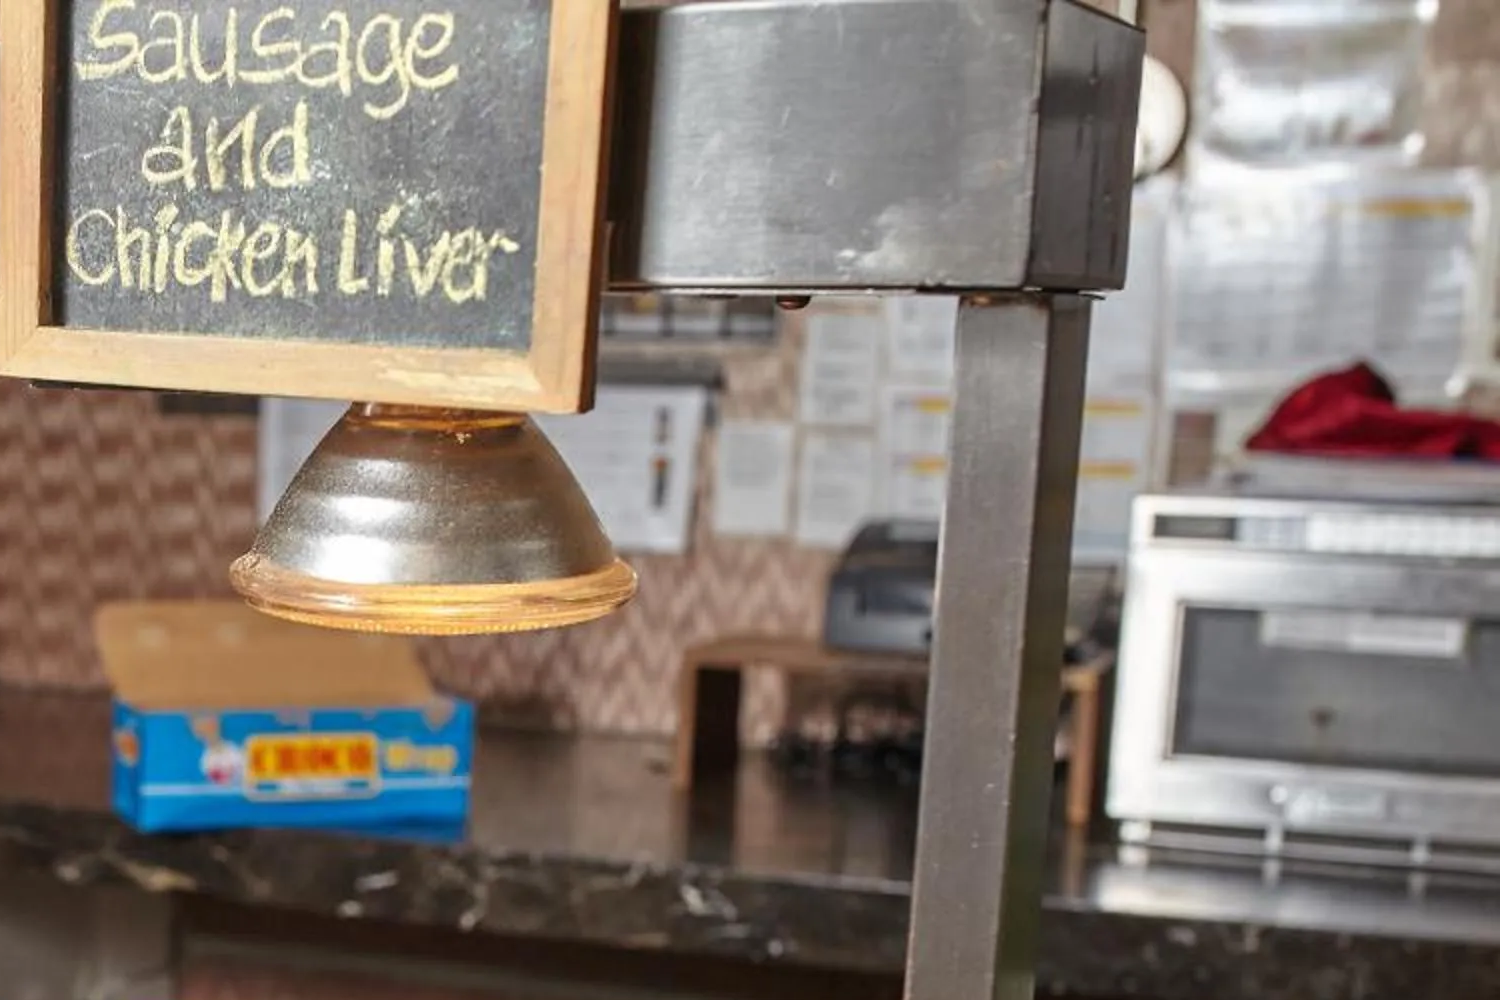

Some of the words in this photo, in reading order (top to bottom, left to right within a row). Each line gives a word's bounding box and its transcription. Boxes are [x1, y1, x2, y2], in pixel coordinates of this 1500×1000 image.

[75, 0, 459, 118] Sausage
[142, 100, 311, 191] and
[65, 203, 318, 302] Chicken
[337, 204, 519, 303] Liver
